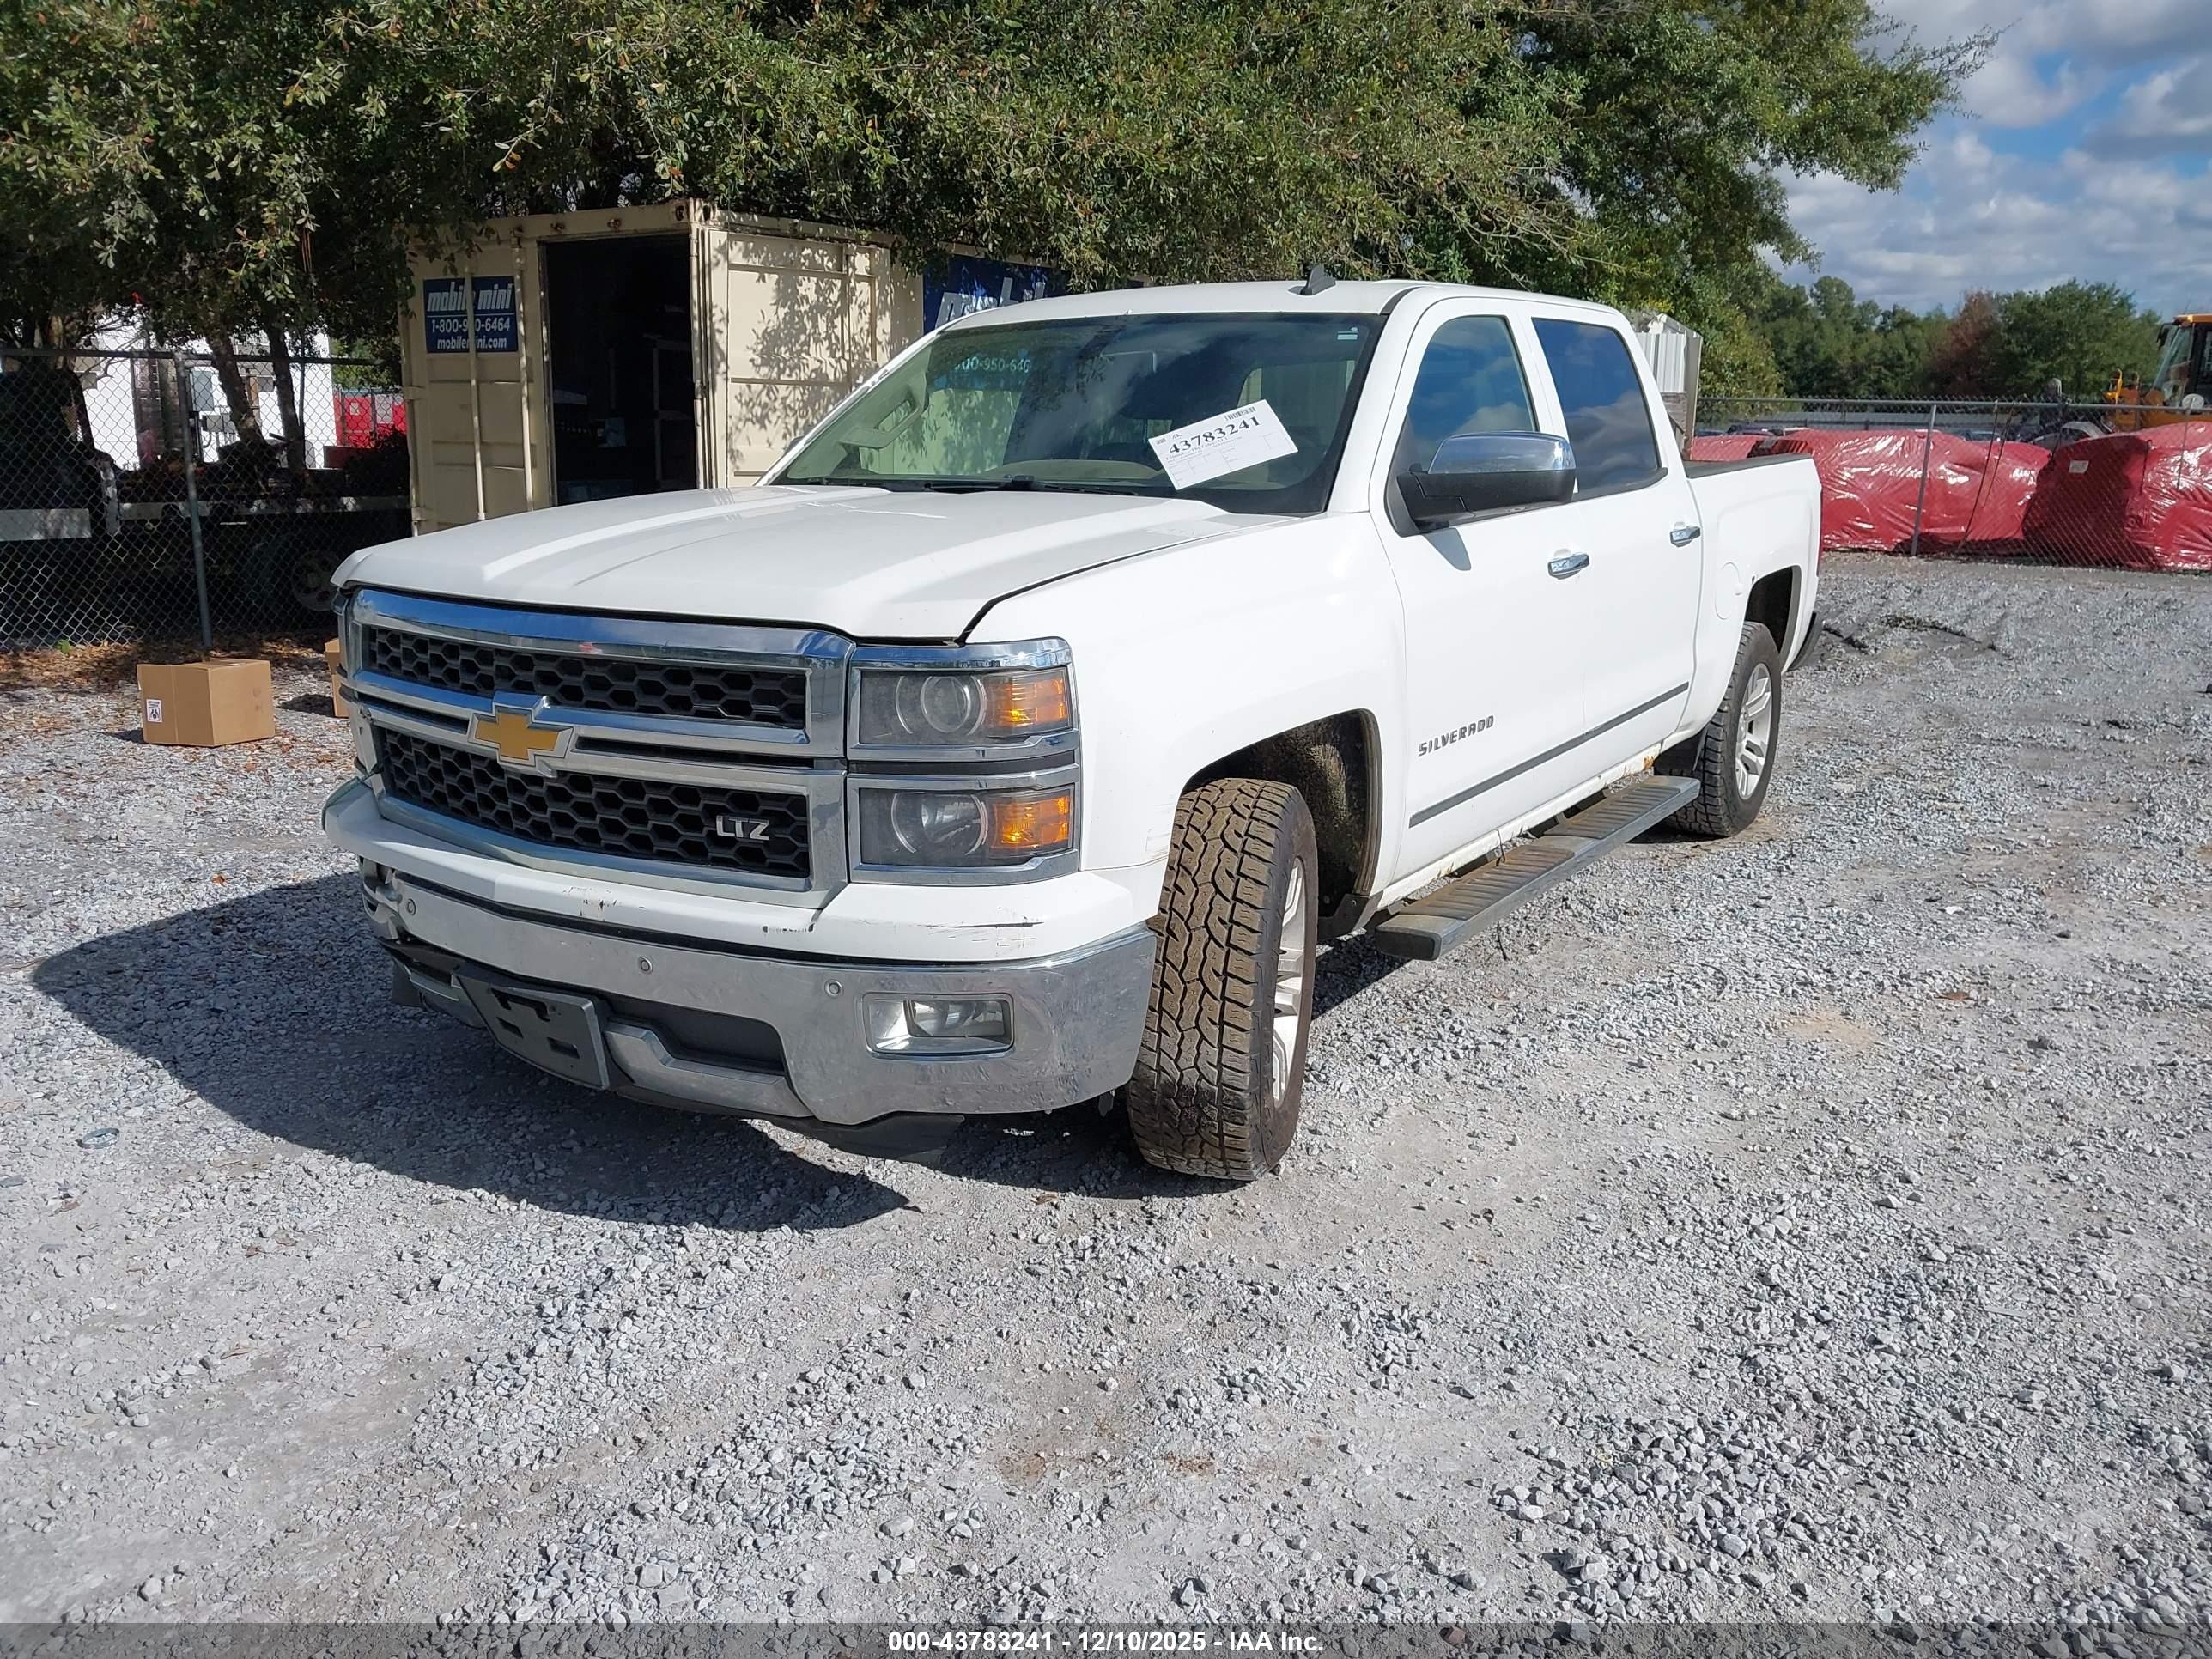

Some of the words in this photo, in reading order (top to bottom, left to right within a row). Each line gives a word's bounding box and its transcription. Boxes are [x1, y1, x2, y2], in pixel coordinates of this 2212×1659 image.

[427, 282, 475, 312] mobil
[477, 283, 514, 310] mini
[431, 317, 510, 333] 1-800-90-6464
[437, 336, 507, 350] mobileni.com
[1170, 416, 1260, 453] 43783241
[1419, 715, 1494, 757] SILVERADO
[716, 815, 769, 840] LTZ
